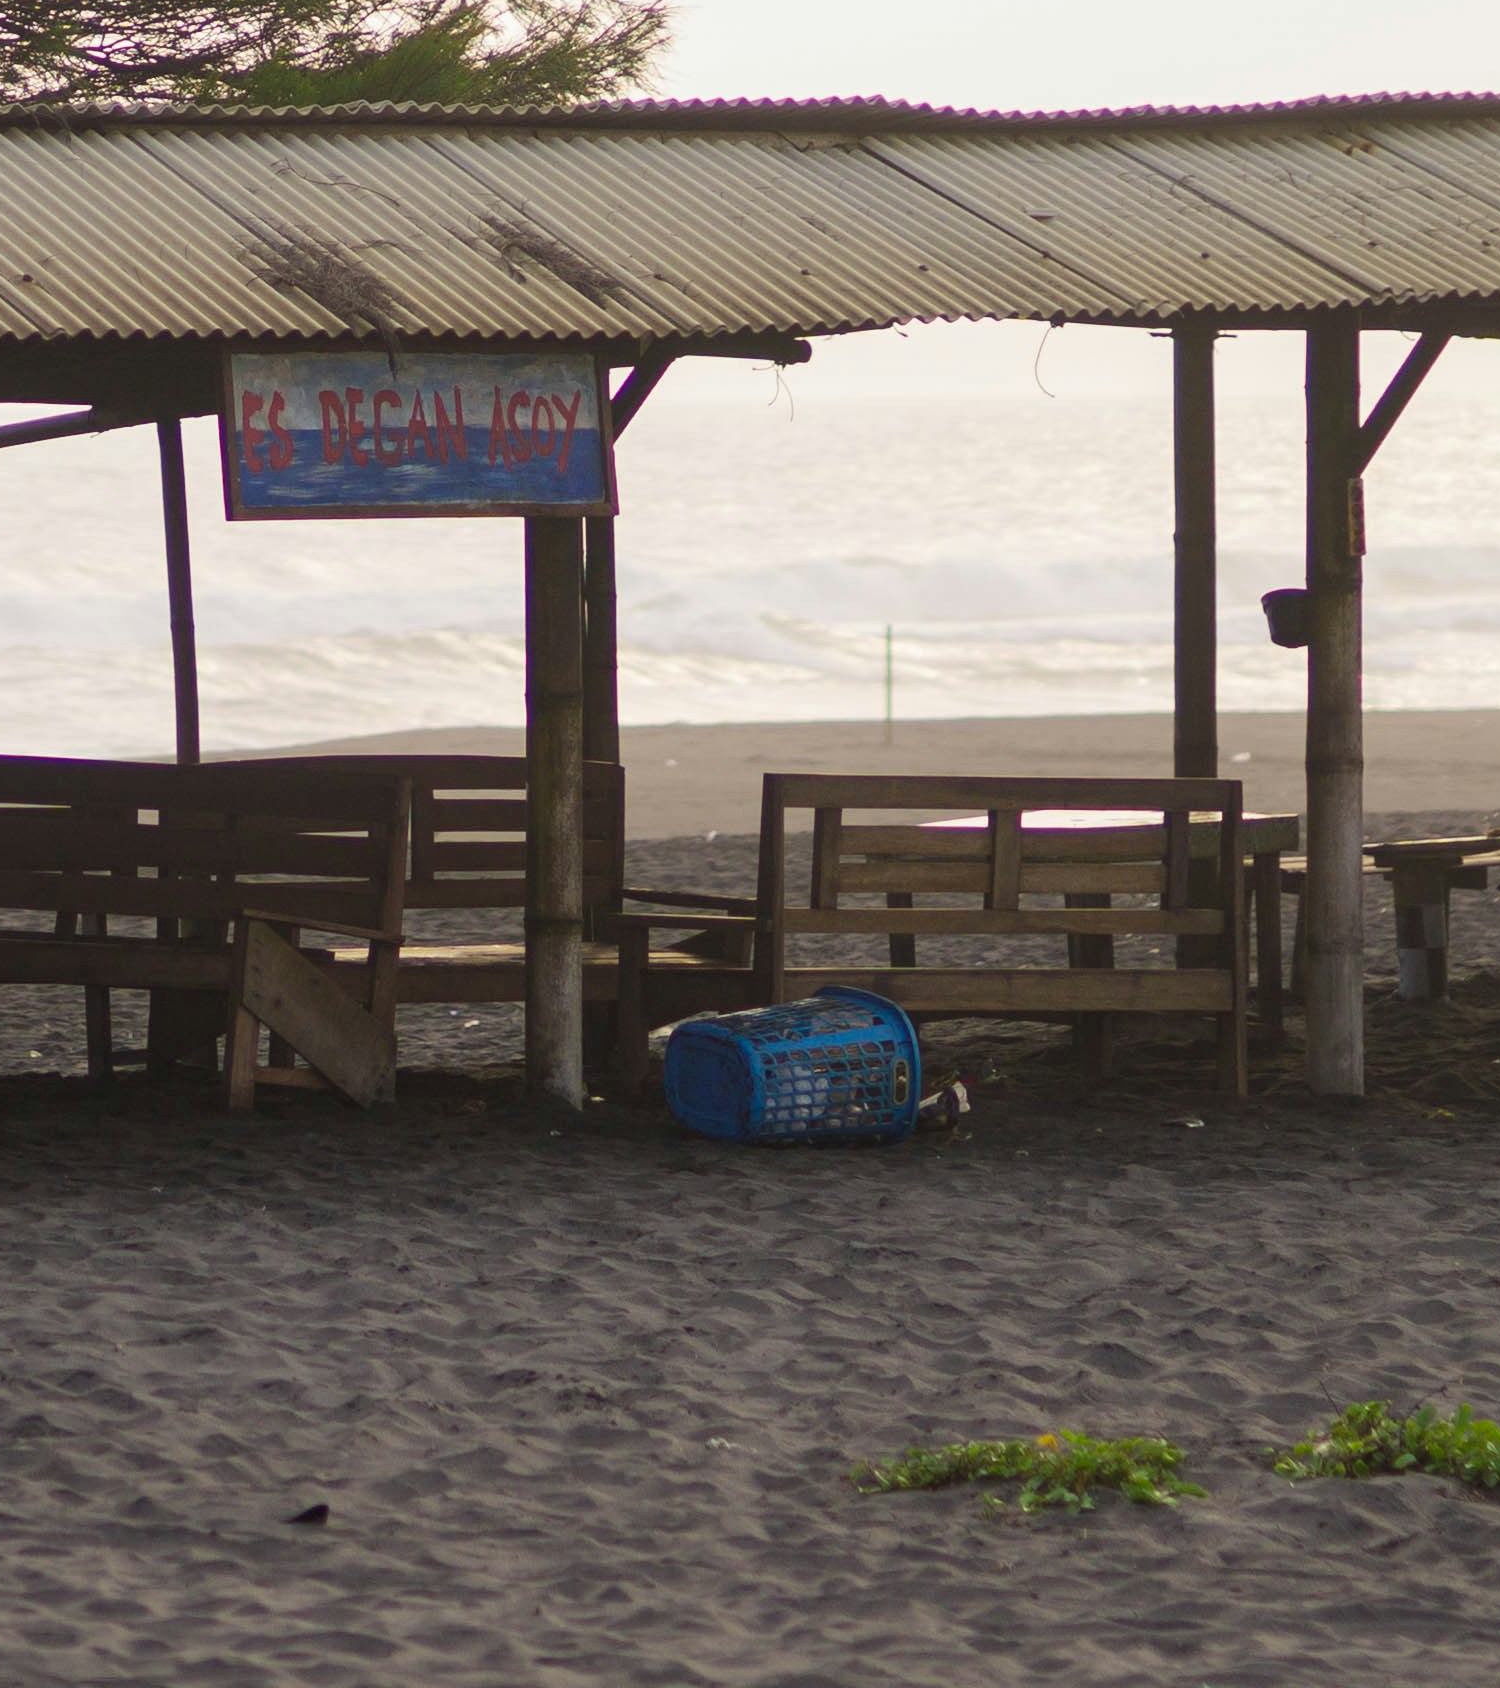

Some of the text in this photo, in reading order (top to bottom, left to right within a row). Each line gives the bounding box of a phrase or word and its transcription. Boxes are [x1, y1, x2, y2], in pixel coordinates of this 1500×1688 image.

[241, 385, 582, 475] ES DEGAN ASOY
